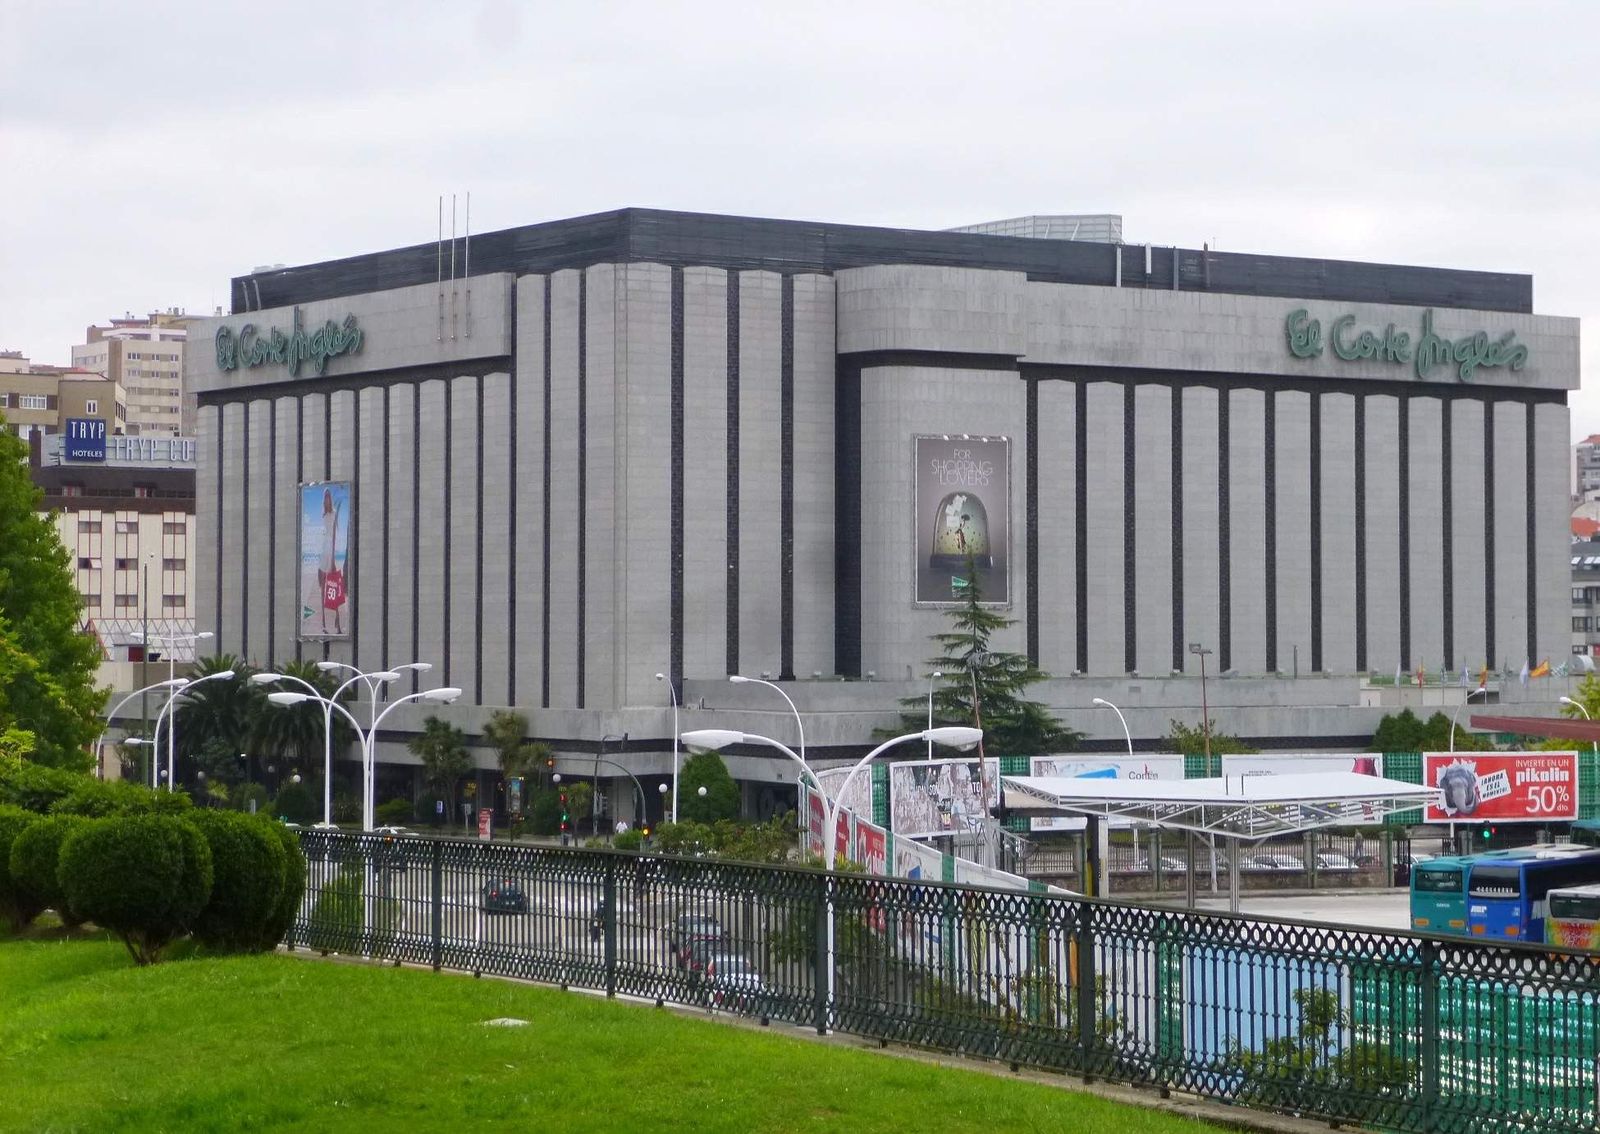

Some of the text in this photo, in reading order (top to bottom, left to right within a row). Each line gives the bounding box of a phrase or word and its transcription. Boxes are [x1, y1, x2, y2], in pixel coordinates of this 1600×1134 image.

[1287, 309, 1322, 358] El
[1333, 314, 1410, 363] Corte
[216, 326, 236, 370] El
[240, 324, 285, 368] Corte
[71, 422, 105, 439] TRYP
[72, 450, 103, 458] HOTELES
[114, 438, 158, 461] TRYP
[953, 448, 972, 460] FOR
[931, 459, 994, 475] SHOPPING
[939, 471, 990, 486] LOVERS
[1558, 759, 1569, 767] UN
[1516, 767, 1570, 786] pikolin
